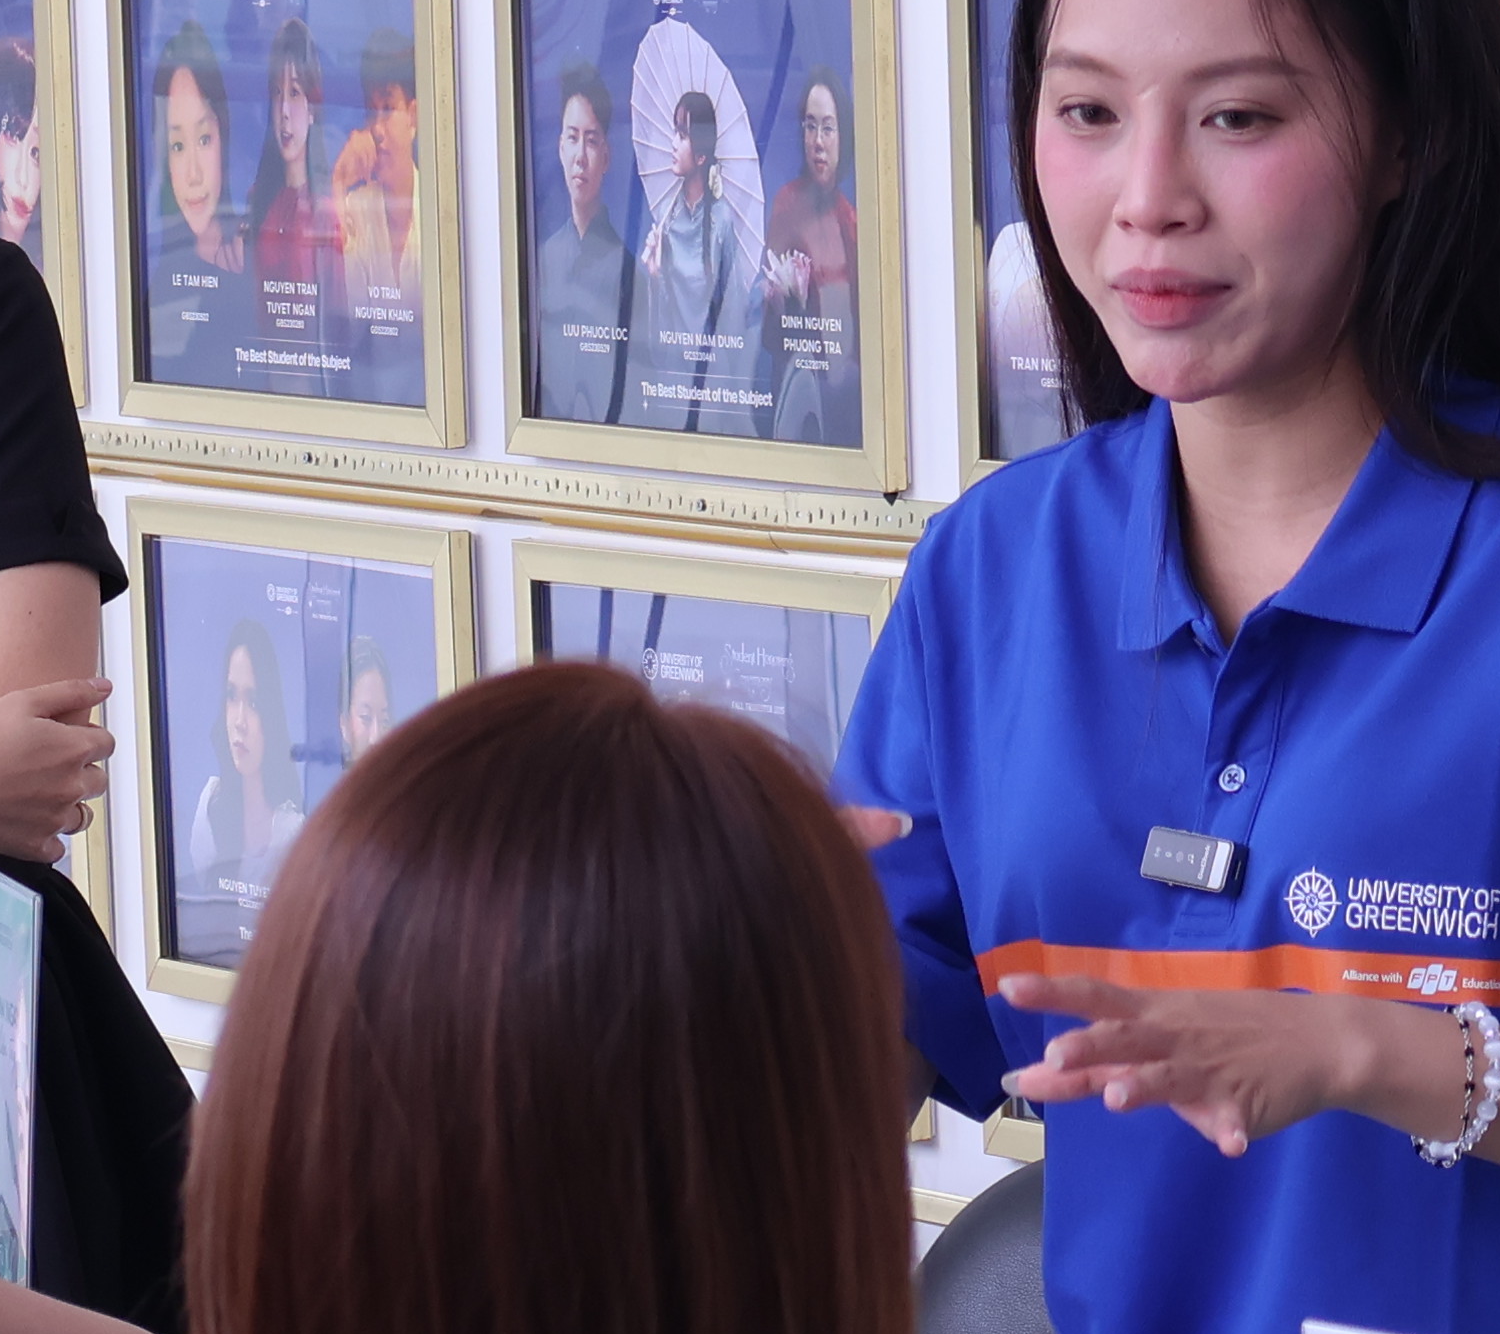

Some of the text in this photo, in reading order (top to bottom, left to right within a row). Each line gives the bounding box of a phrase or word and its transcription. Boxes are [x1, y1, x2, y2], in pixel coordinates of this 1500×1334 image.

[172, 274, 218, 288] LE TAM HIEN
[264, 281, 318, 296] NGUYEN TRAN
[368, 286, 401, 300] VO TRAN
[267, 302, 315, 316] TUYET NGAN
[355, 307, 413, 322] NGUYEN KHANG
[781, 315, 842, 332] DINH NGUYEN
[563, 324, 580, 337] LUU
[611, 327, 628, 341] LOC
[660, 331, 744, 349] NGUYEN NAM DUNG
[784, 338, 842, 355] PHUONG TRA
[236, 348, 350, 371] The Best Student of the Subject
[1010, 357, 1038, 371] TRAN
[642, 382, 772, 408] The Best Student of the Subject
[660, 652, 703, 667] UNIVERSITY OF
[661, 665, 704, 683] GREENWICH
[1348, 877, 1470, 910] UNIVERSITY
[1345, 903, 1499, 940] GREENWICH
[1342, 969, 1379, 983] Alliance
[1381, 972, 1402, 983] with
